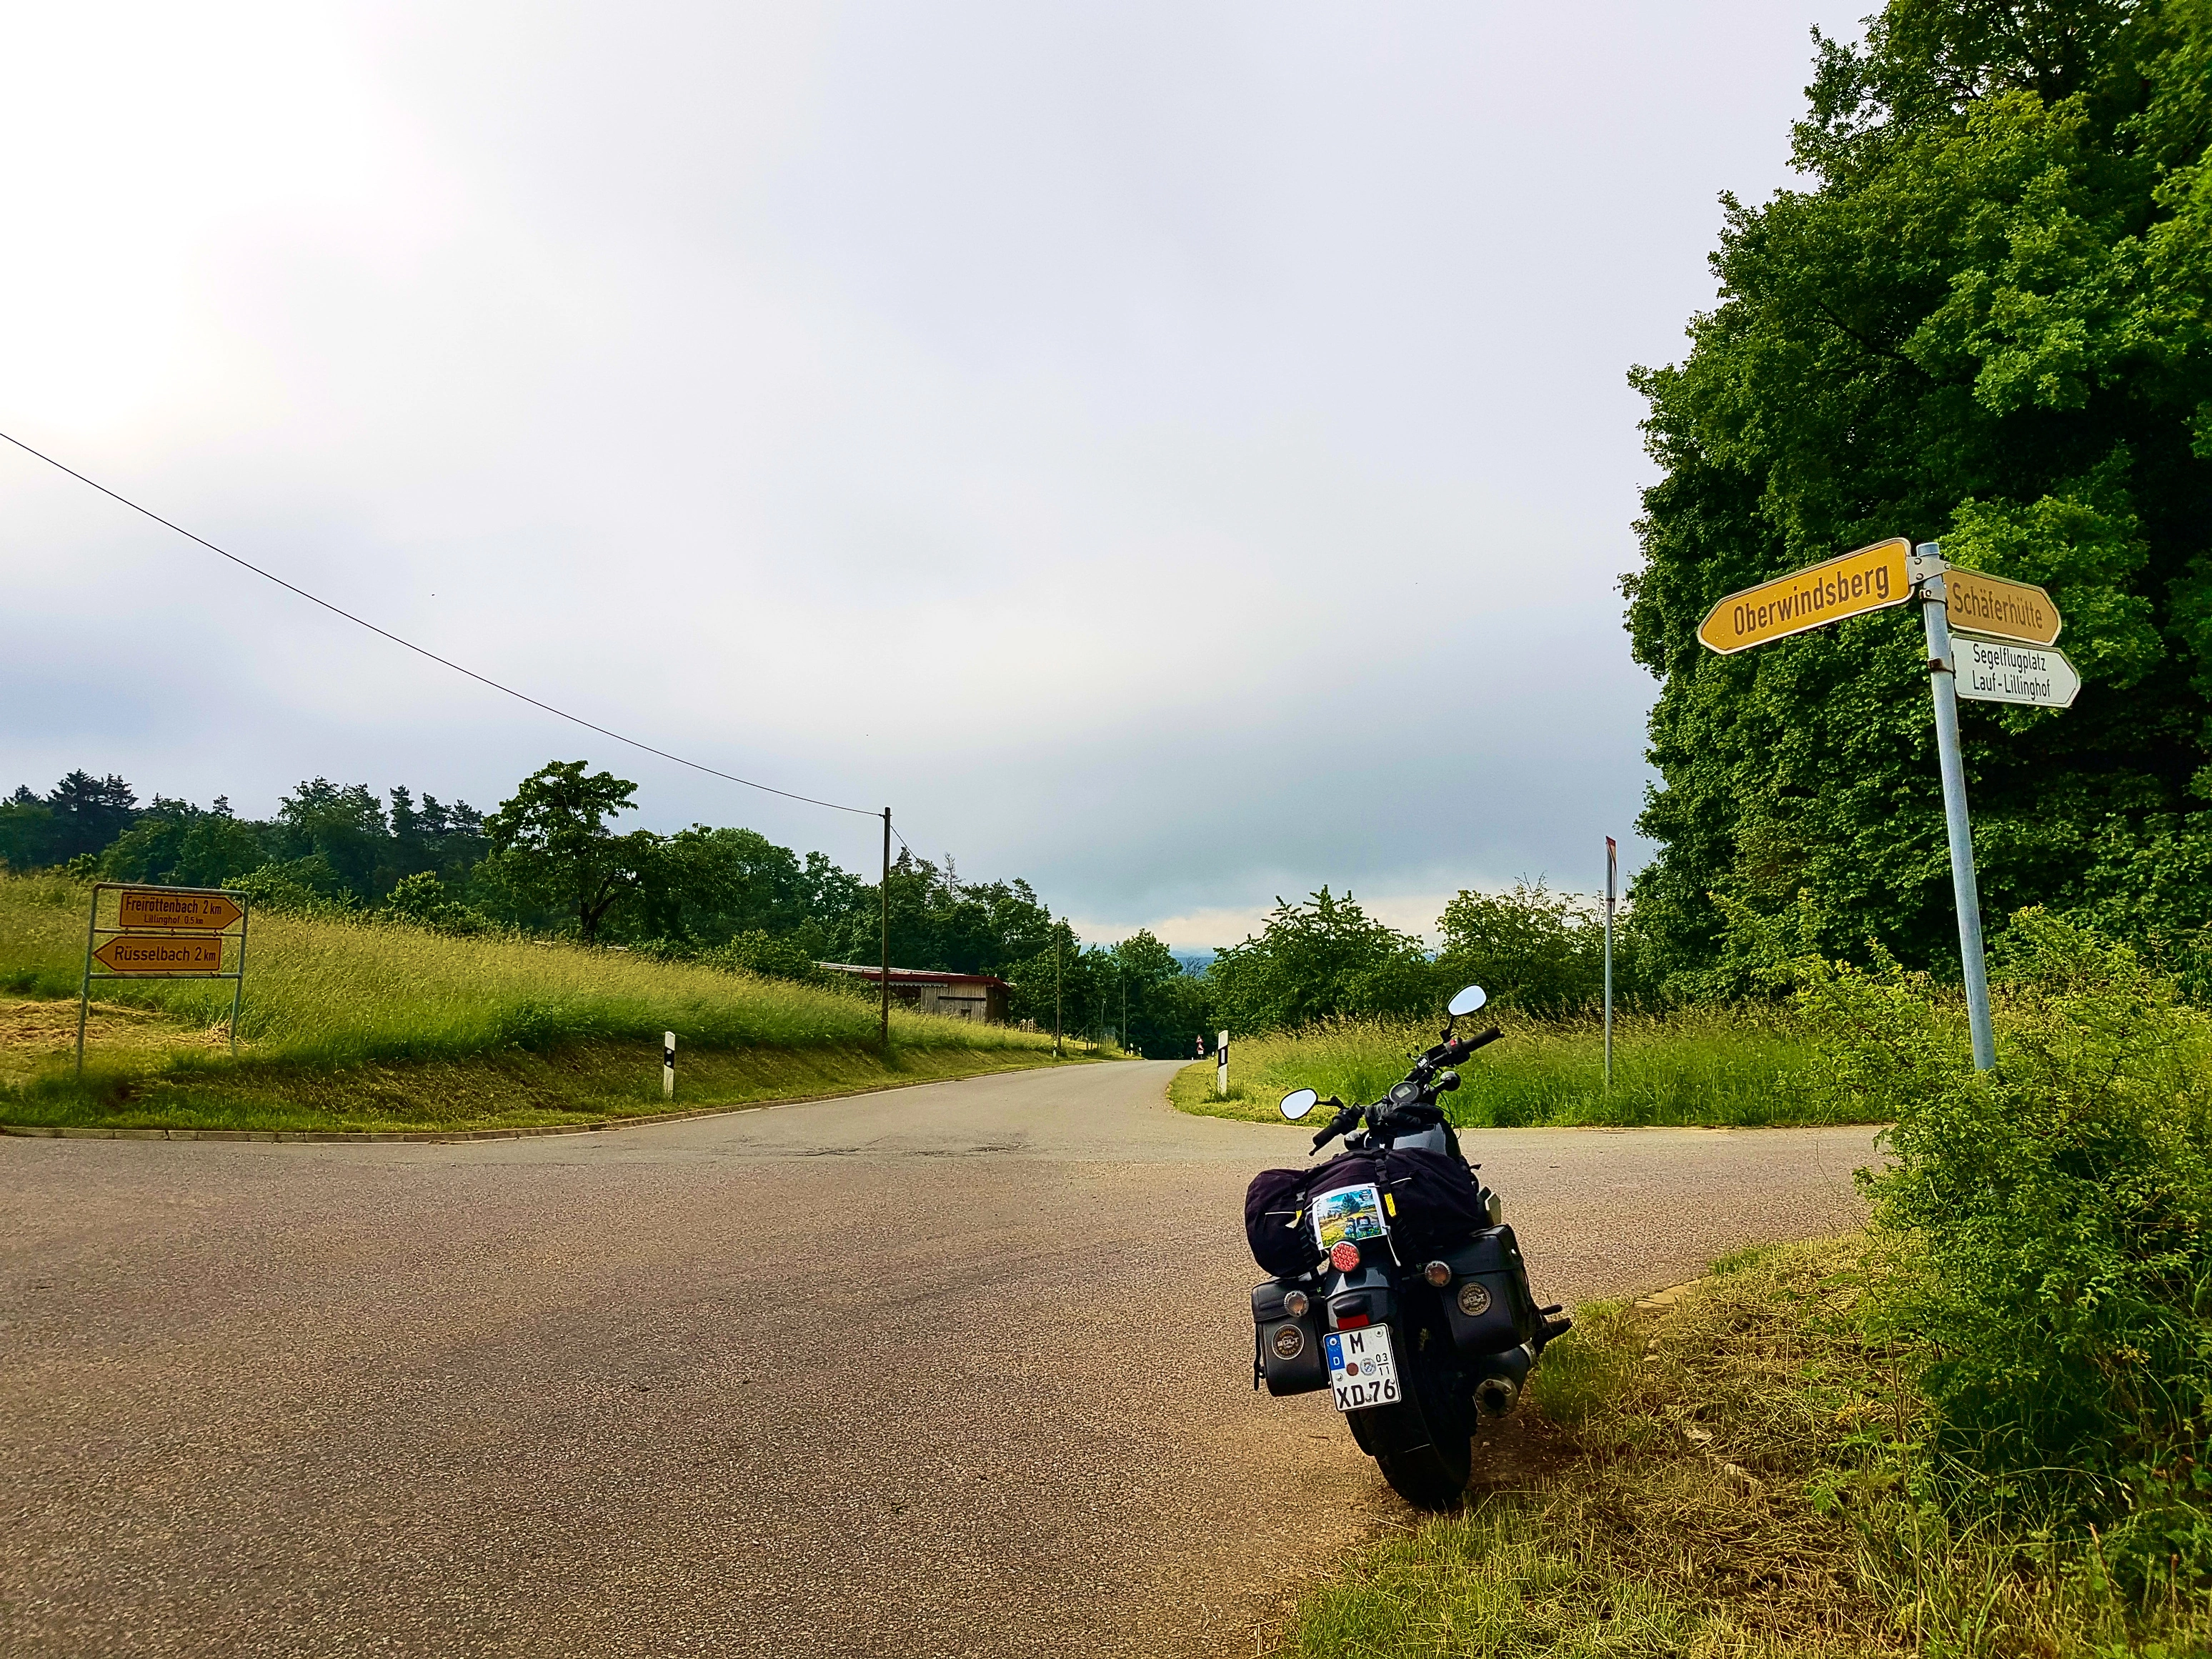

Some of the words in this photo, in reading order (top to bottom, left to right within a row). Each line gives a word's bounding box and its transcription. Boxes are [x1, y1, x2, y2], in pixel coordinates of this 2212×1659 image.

[1733, 565, 1890, 636] Oberwindsberg
[1952, 582, 2043, 629] Schäferhütte
[1973, 643, 2047, 674] Segelflugplatz
[125, 895, 199, 914] Freiröttenbach
[202, 900, 209, 915] 2
[210, 902, 222, 915] km
[144, 914, 181, 926] Lillinghof
[114, 945, 190, 961] Rüsselbach
[194, 946, 202, 961] 2
[204, 948, 216, 962] km
[1277, 1337, 1300, 1347] BOLT
[1349, 1332, 1365, 1354] M
[1332, 1356, 1340, 1366] D
[1375, 1352, 1388, 1362] 03
[1379, 1365, 1390, 1376] 11
